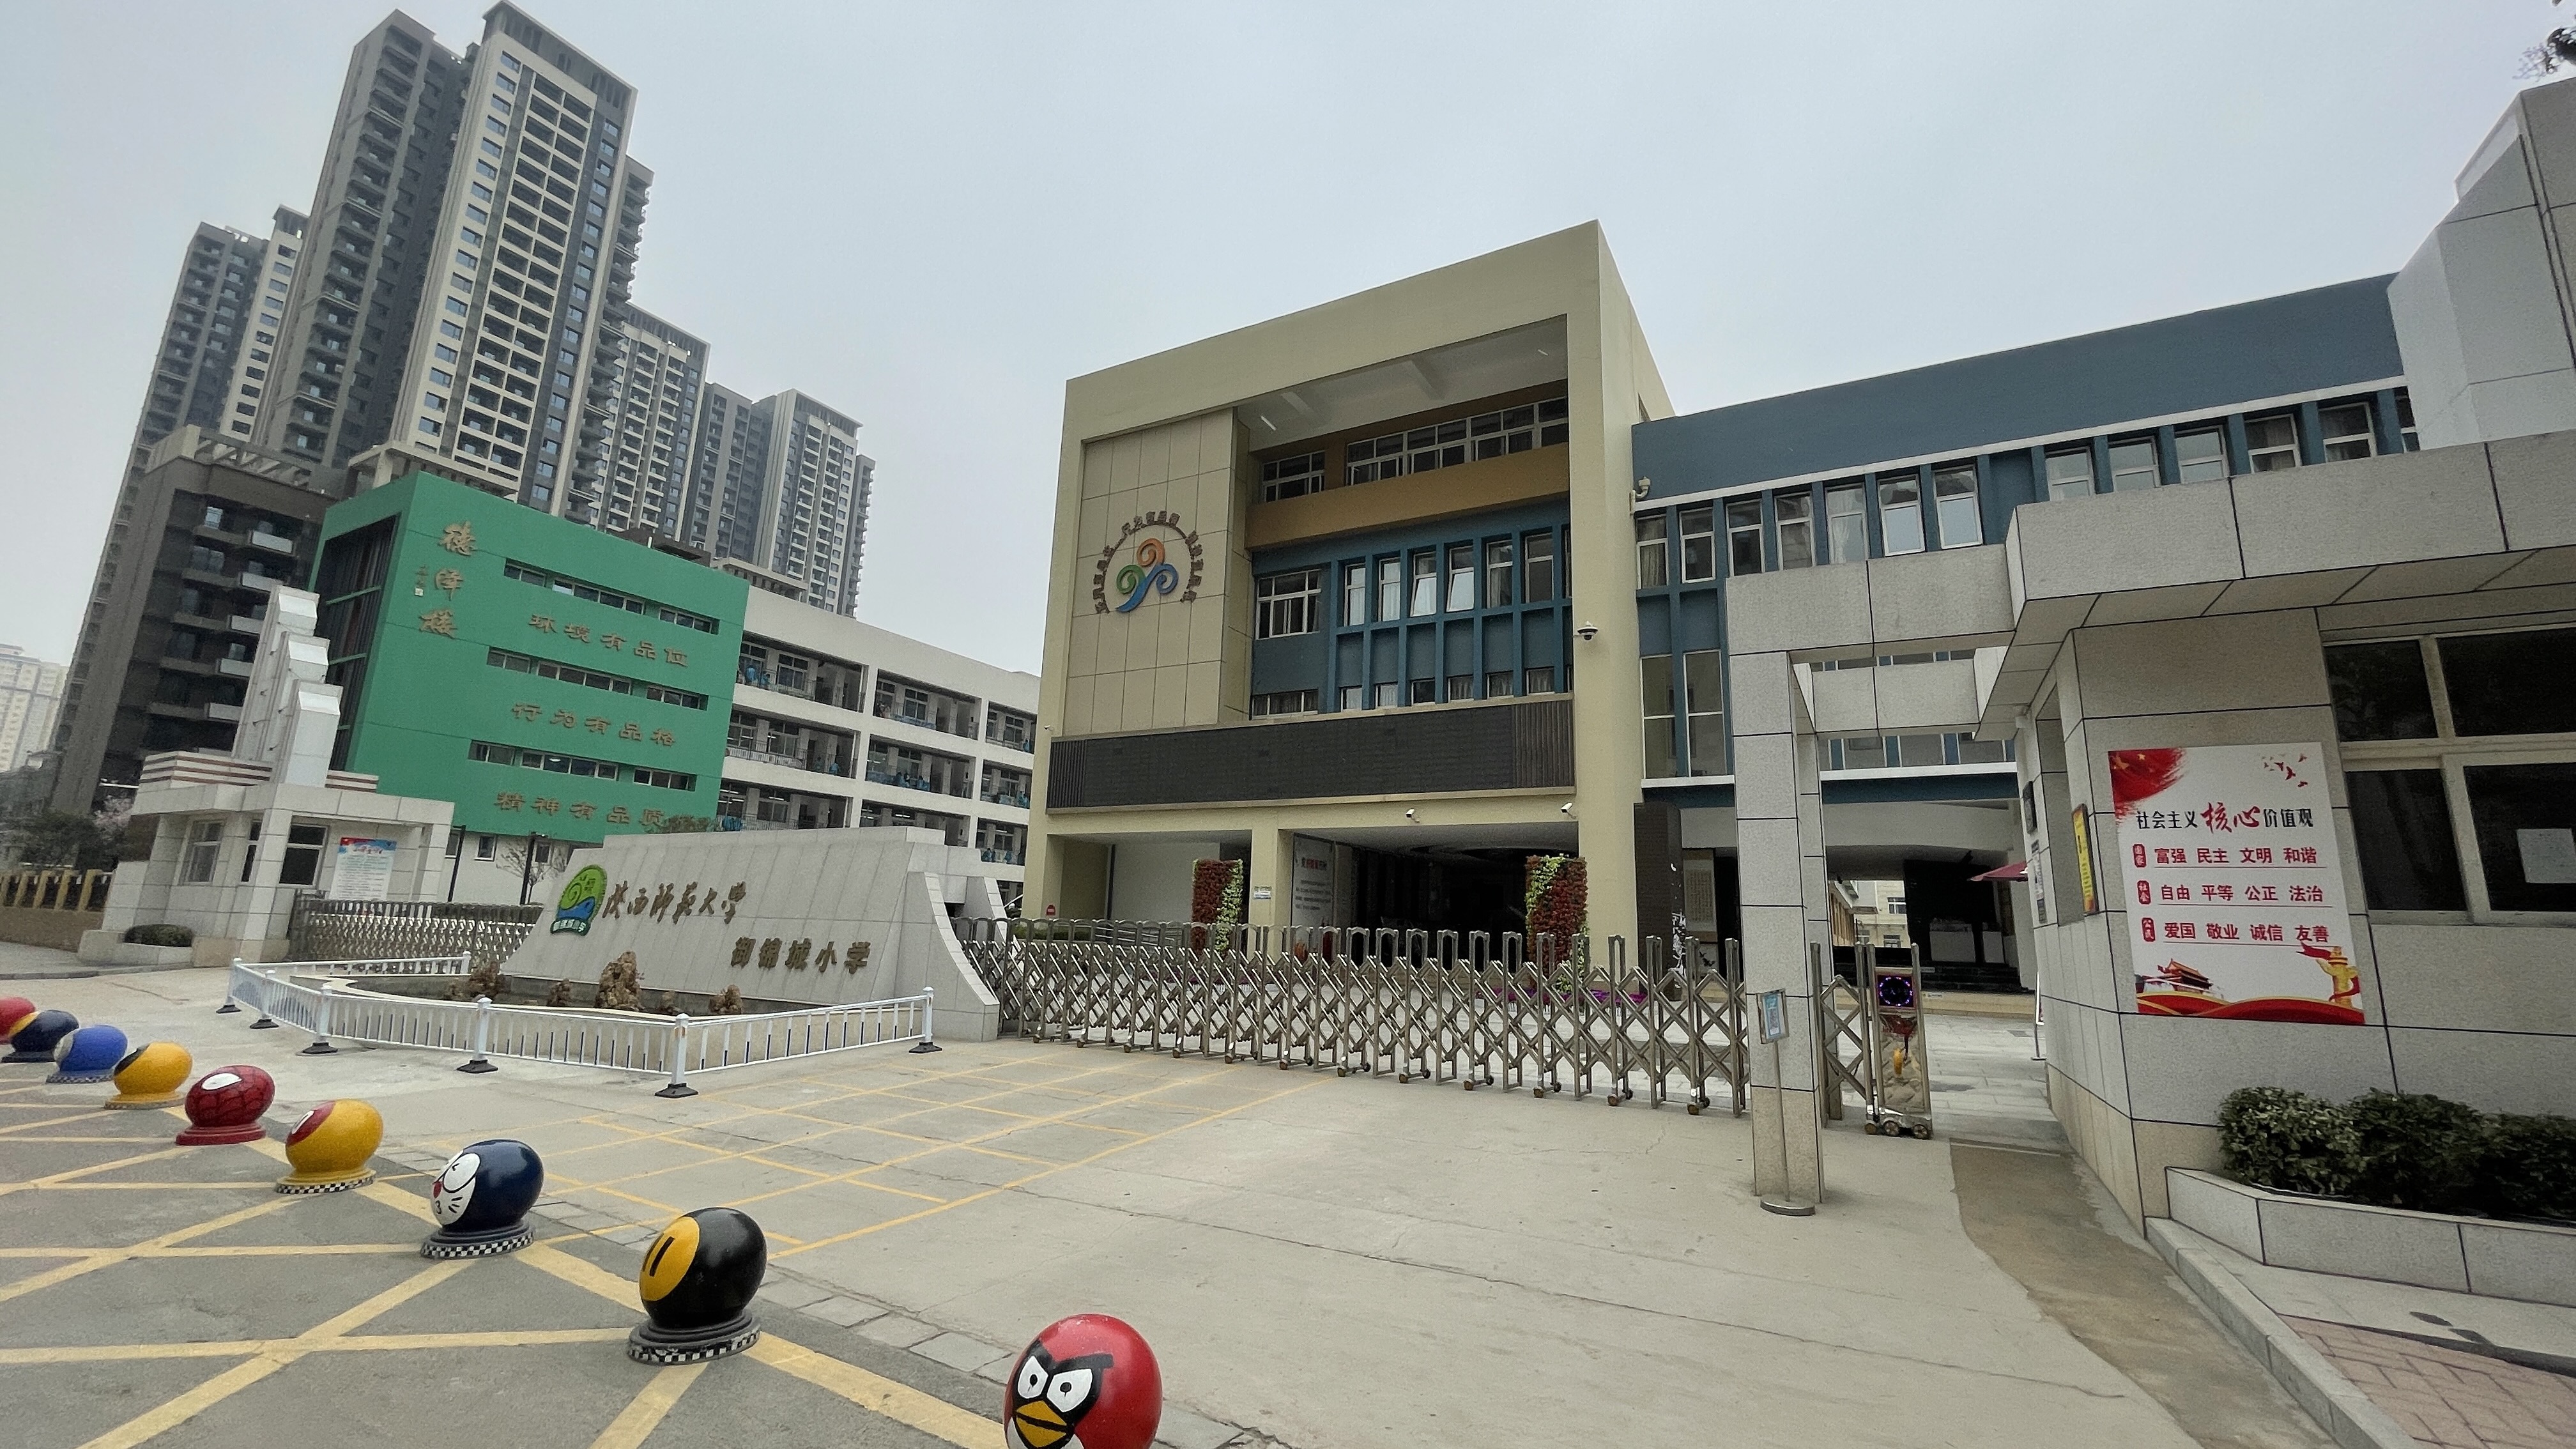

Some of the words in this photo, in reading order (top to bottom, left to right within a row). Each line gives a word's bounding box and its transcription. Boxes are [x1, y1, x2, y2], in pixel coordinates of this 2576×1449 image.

[528, 615, 688, 667] 环境有品位
[512, 702, 676, 746] 行为有品格
[494, 792, 668, 827] 精神有品质
[2136, 802, 2313, 833] 社会主义核心价值观
[2154, 847, 2187, 864] 富强
[2197, 848, 2230, 864] 民主
[2239, 847, 2273, 864] 文明
[2283, 847, 2317, 864] 和谐
[2161, 884, 2190, 901] 自由
[2202, 885, 2234, 901] 平等
[2244, 885, 2278, 901] 公正
[2288, 885, 2323, 902] 法治
[2165, 922, 2196, 939] 爱国
[2206, 923, 2240, 940] 敬业
[2250, 924, 2283, 942] 诚信
[2295, 924, 2329, 943] 友善
[730, 937, 871, 975] 御锦城小学
